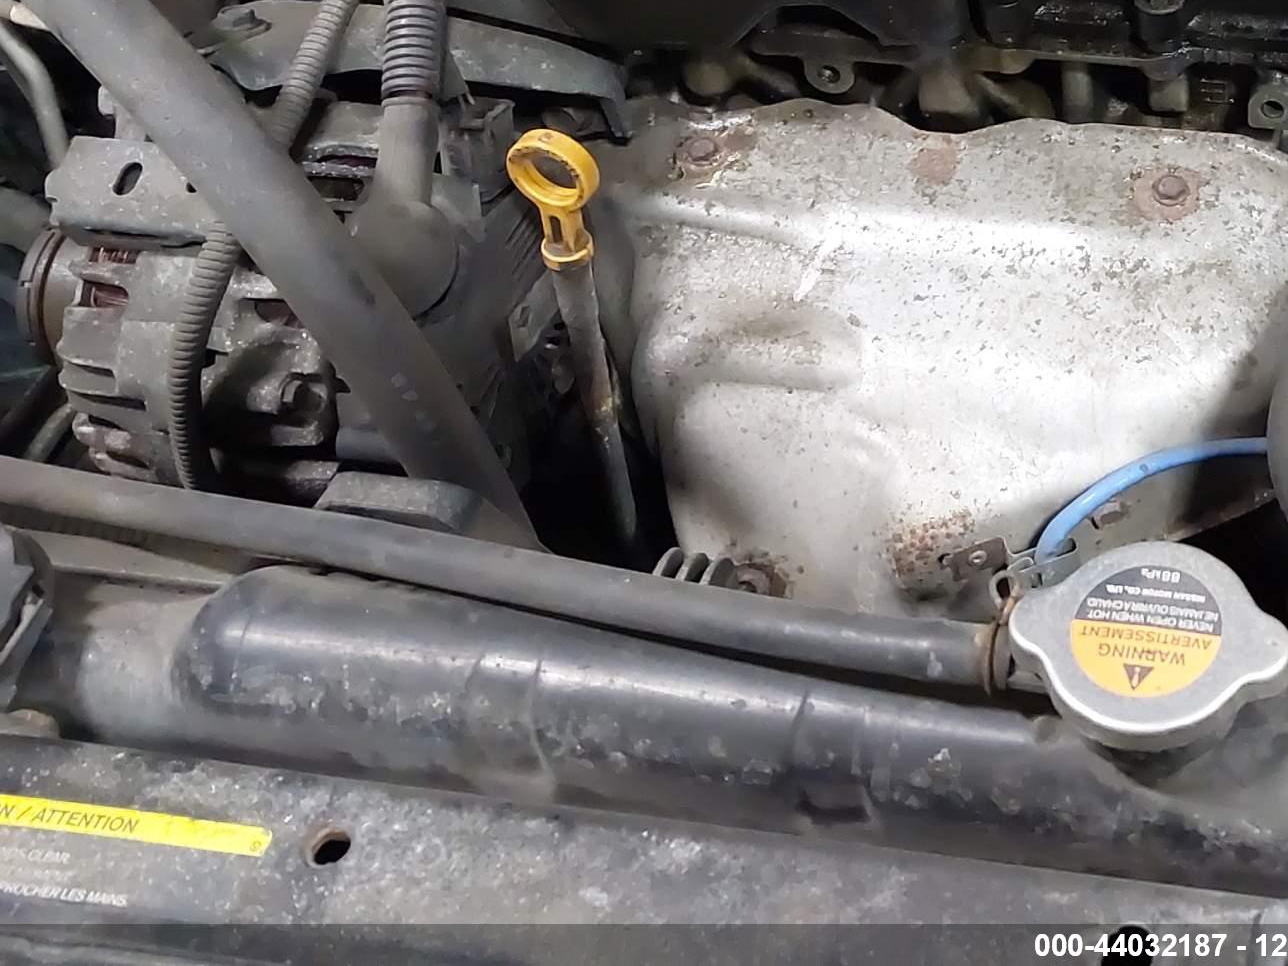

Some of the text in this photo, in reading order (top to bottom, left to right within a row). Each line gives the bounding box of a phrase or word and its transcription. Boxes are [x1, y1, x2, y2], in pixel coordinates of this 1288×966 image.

[1162, 570, 1180, 583] 88
[1142, 587, 1172, 598] MOTOR
[1173, 591, 1206, 603] NISSAN
[1130, 601, 1168, 614] OUVRIR
[1169, 605, 1204, 619] JAMAIS
[1111, 611, 1145, 624] WHEN
[1146, 615, 1176, 628] OPEN
[1204, 611, 1218, 621] NE
[1179, 619, 1214, 632] NEVER
[1079, 625, 1212, 650] AVERTISSEMENT
[1098, 642, 1186, 666] WARNING
[33, 807, 140, 834] ATTENTION
